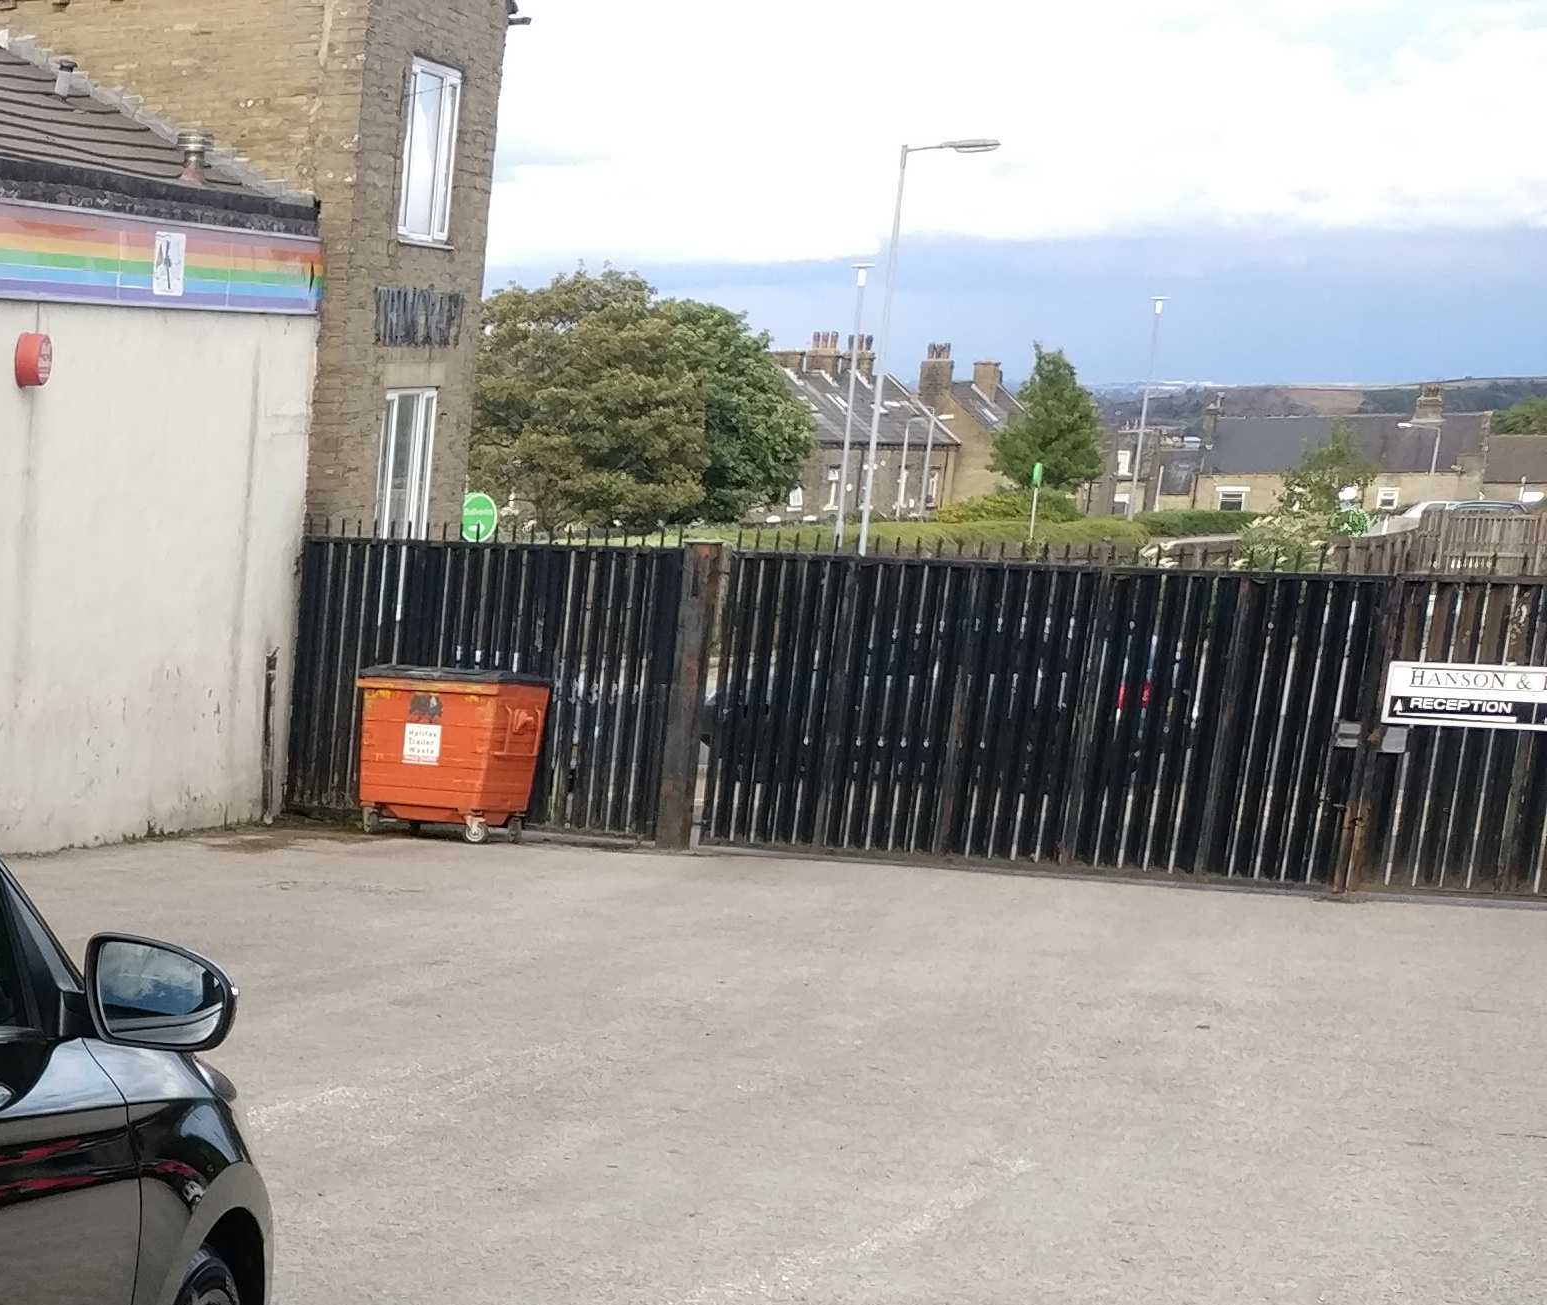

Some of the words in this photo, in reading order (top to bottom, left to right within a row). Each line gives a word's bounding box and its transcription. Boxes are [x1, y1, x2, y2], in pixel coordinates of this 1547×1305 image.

[1409, 669, 1508, 689] HANSON
[1516, 672, 1533, 690] &
[1409, 697, 1514, 714] RECEPTION
[408, 729, 437, 737] Halifax
[408, 737, 434, 746] Trailer
[408, 746, 435, 754] Waste
